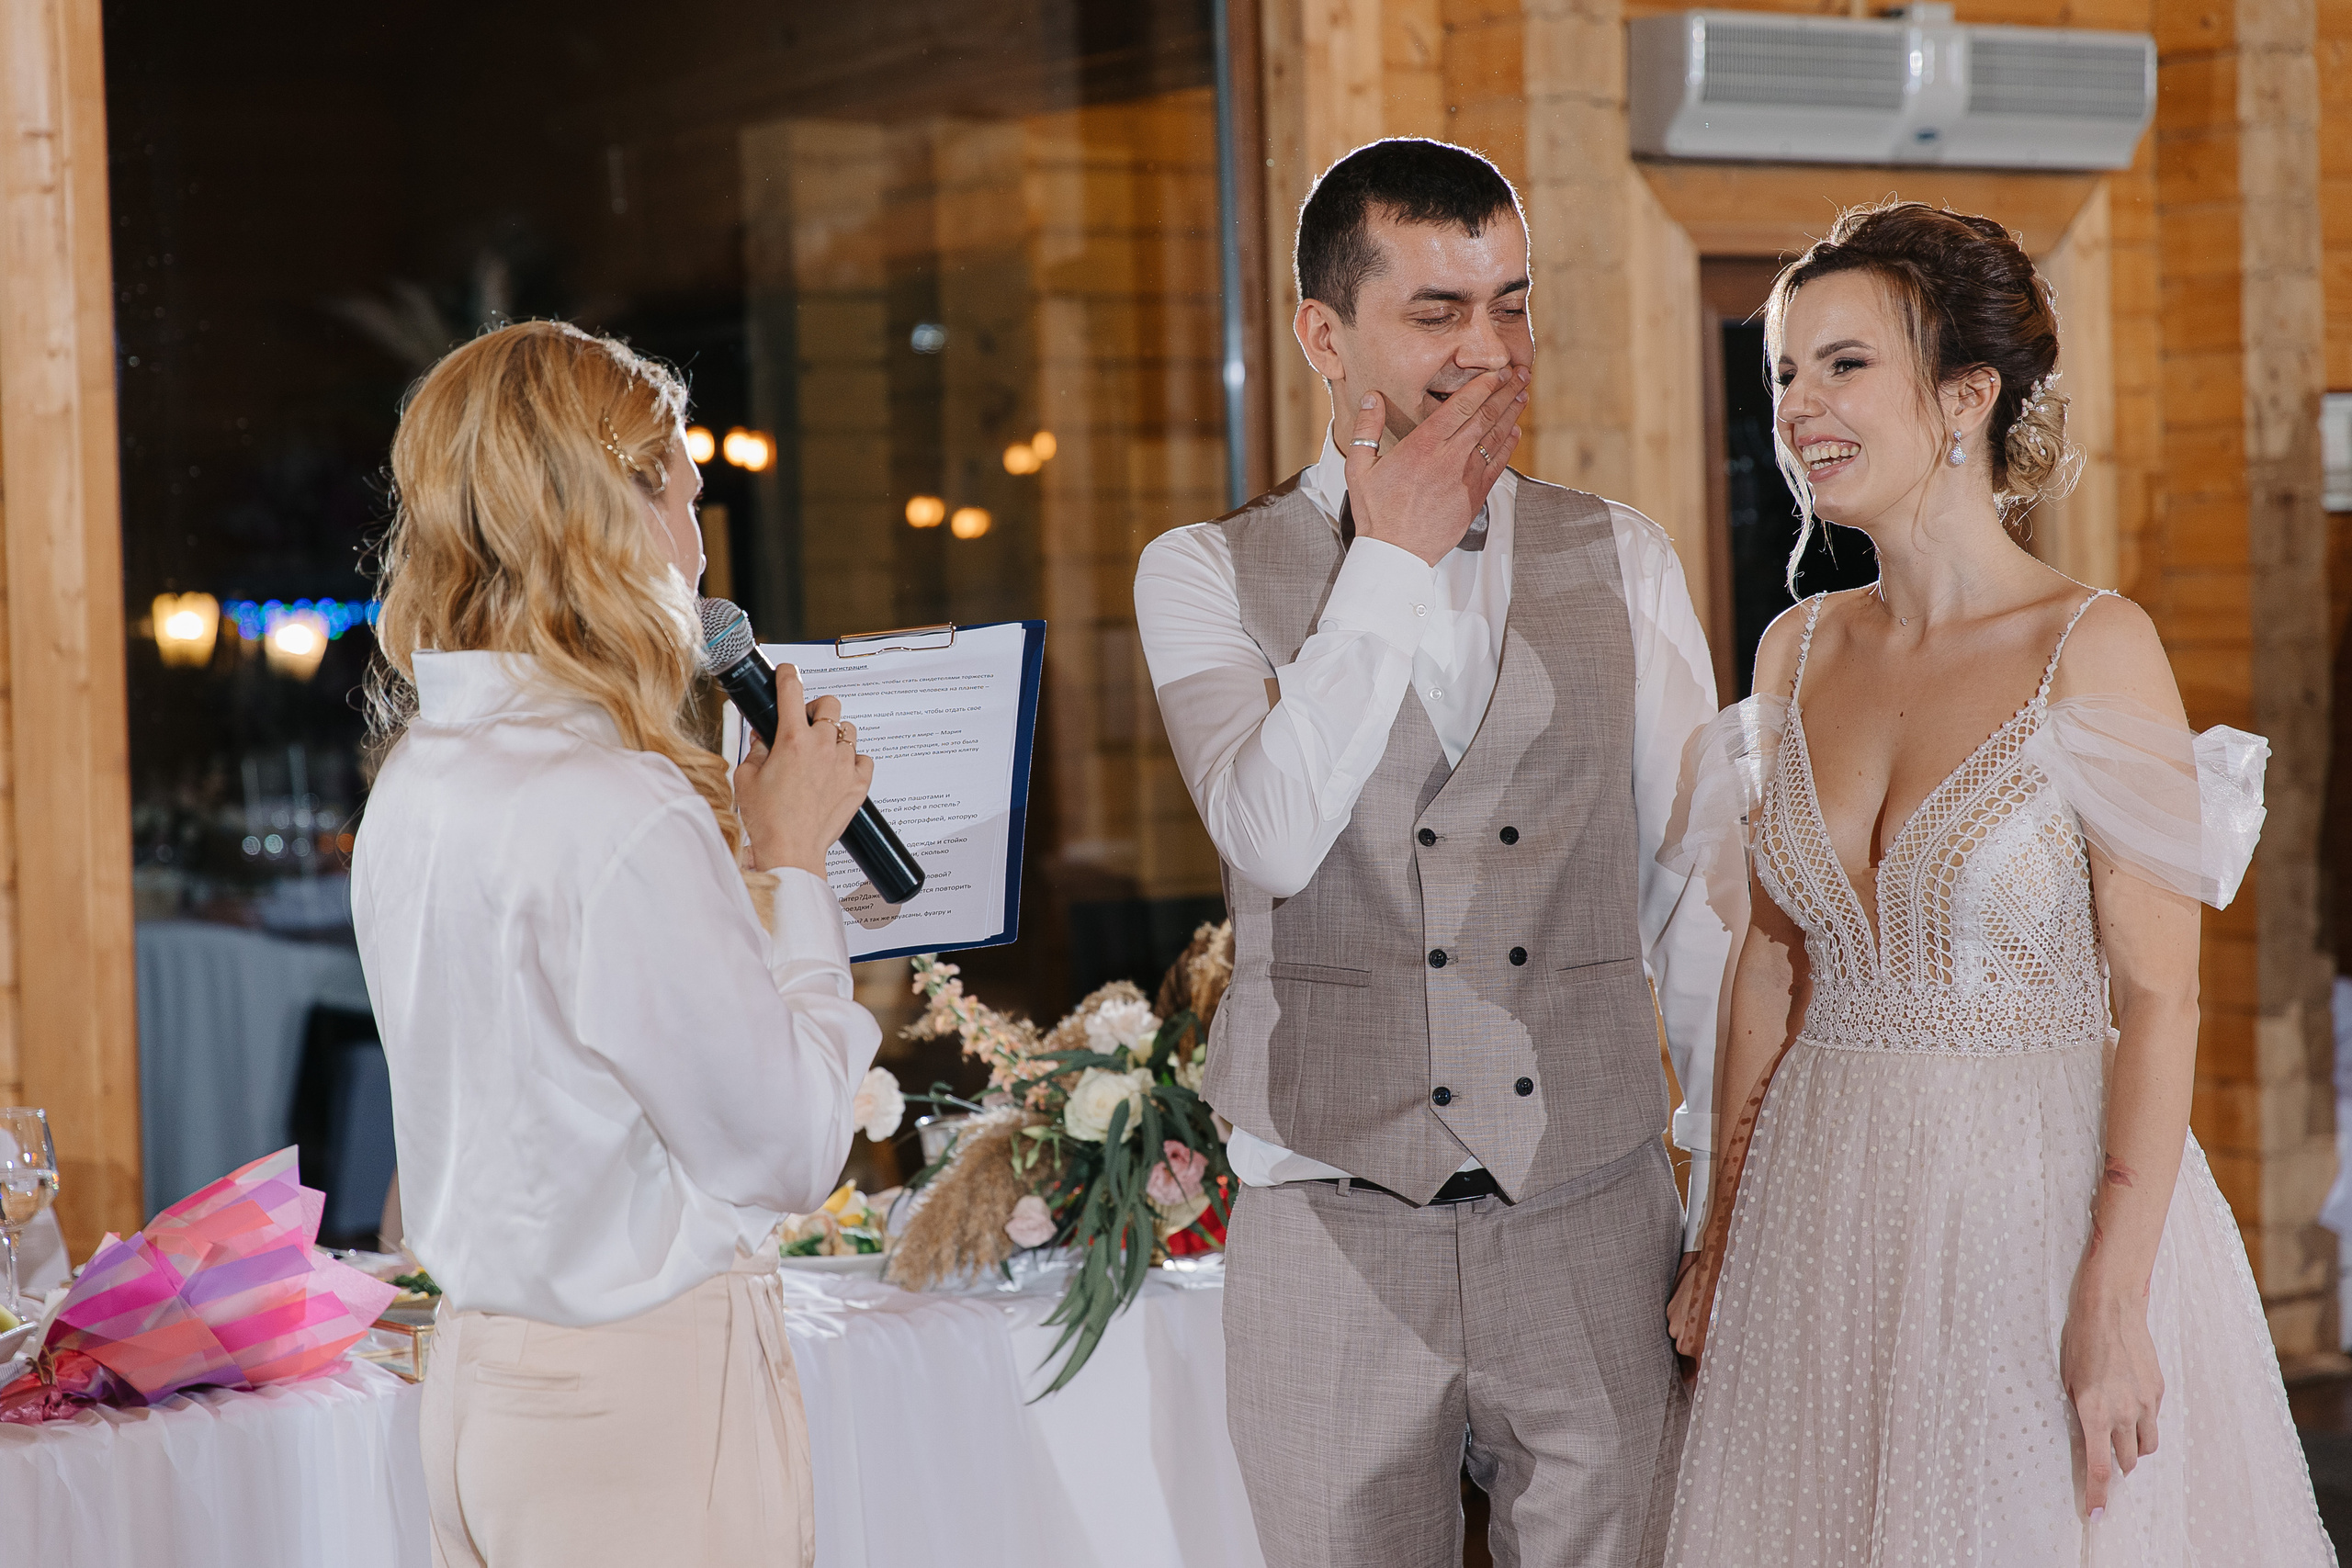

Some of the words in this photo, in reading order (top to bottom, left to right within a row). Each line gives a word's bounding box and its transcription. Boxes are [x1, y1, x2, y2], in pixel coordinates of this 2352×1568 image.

[829, 664, 868, 672] регистрация
[899, 742, 940, 750] регистрация,
[910, 750, 932, 759] самую
[928, 801, 961, 809] постель?
[897, 815, 946, 826] фотографией,
[947, 812, 978, 821] которую
[906, 840, 935, 849] одежды
[943, 837, 968, 845] стойко
[934, 884, 972, 893] повторить
[891, 912, 922, 920] круасаны,
